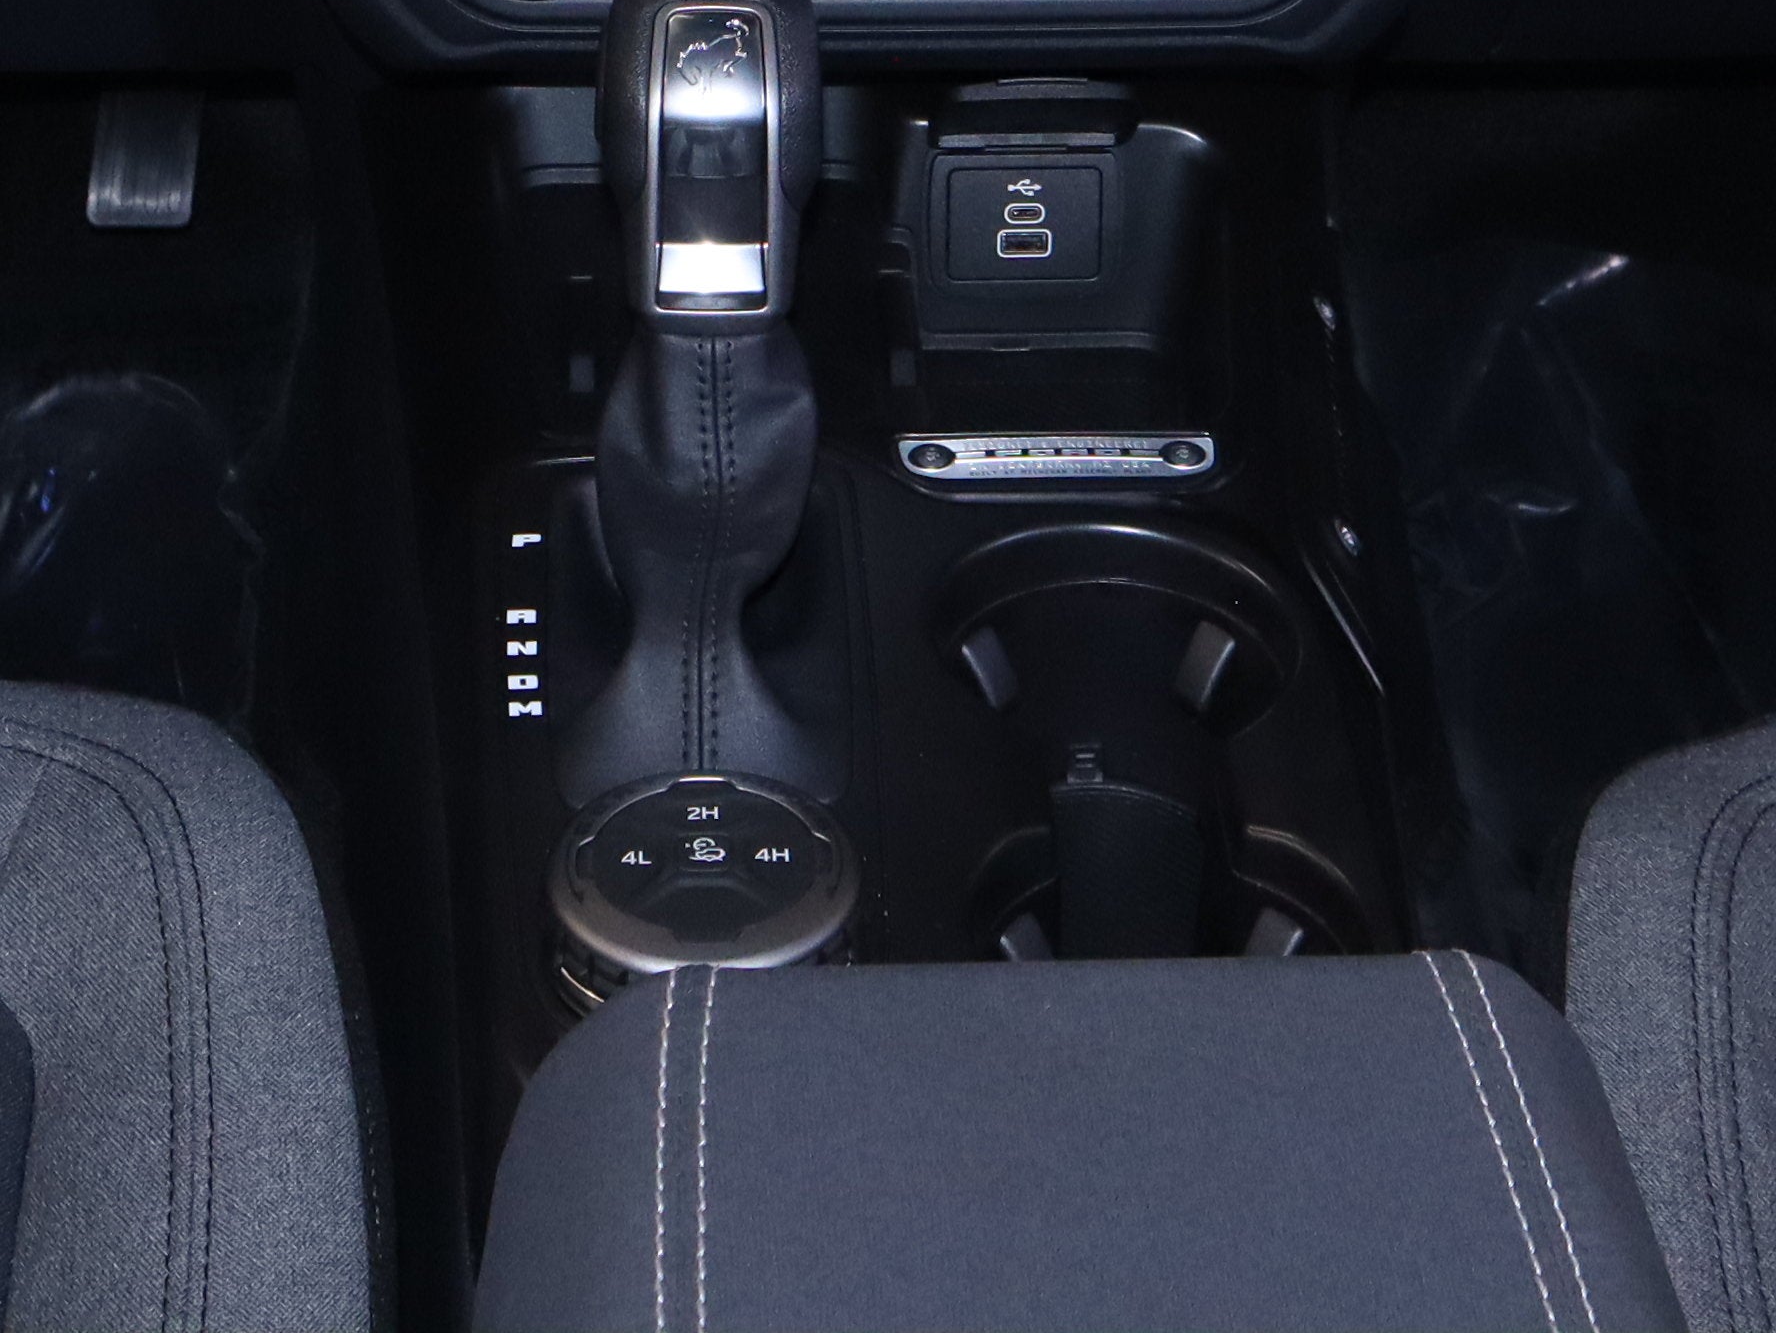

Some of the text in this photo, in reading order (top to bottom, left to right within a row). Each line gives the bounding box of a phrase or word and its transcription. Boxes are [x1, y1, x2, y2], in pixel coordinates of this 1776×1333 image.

[511, 533, 542, 547] P
[506, 608, 537, 624] R
[506, 640, 538, 656] N
[507, 674, 539, 690] D
[508, 700, 543, 717] M
[686, 806, 720, 821] 2H
[620, 850, 652, 866] 4L
[754, 847, 791, 863] 4H
